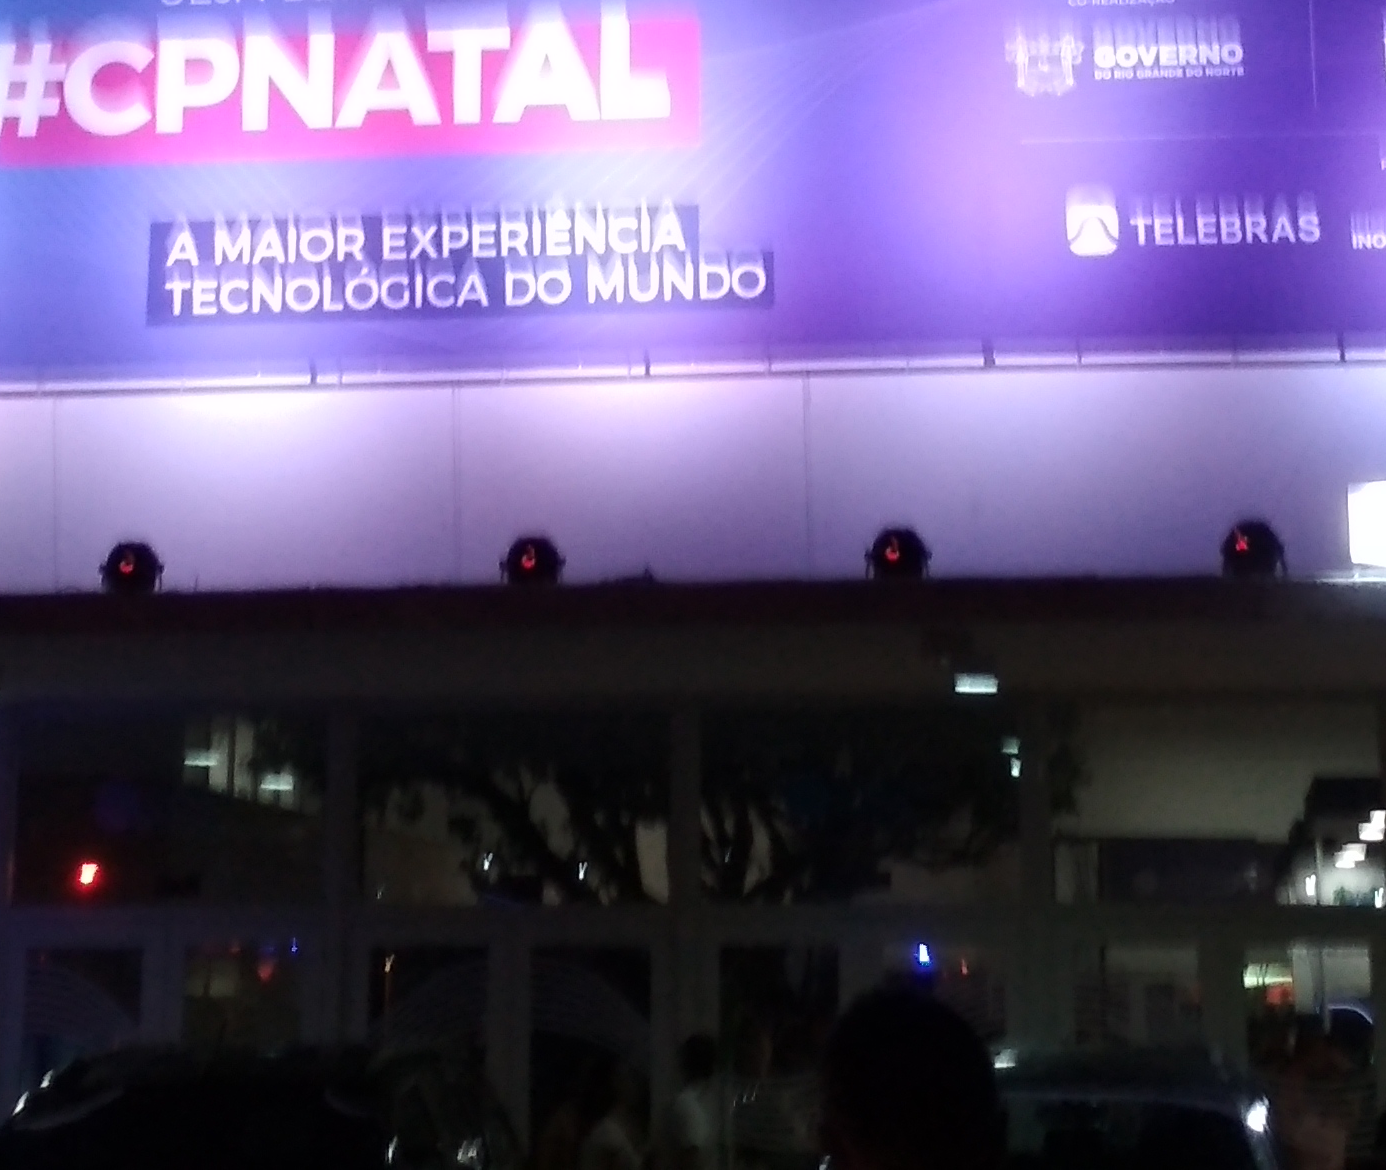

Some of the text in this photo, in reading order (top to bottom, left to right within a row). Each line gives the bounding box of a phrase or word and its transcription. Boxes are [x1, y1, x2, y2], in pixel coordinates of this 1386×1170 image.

[1093, 43, 1244, 69] GOVERNO
[165, 206, 688, 268] A MAIOR EXPERIÊNCIA
[1129, 213, 1321, 246] TELEBRAS
[164, 260, 768, 317] TECNOLÓGICA DO MUNDO
